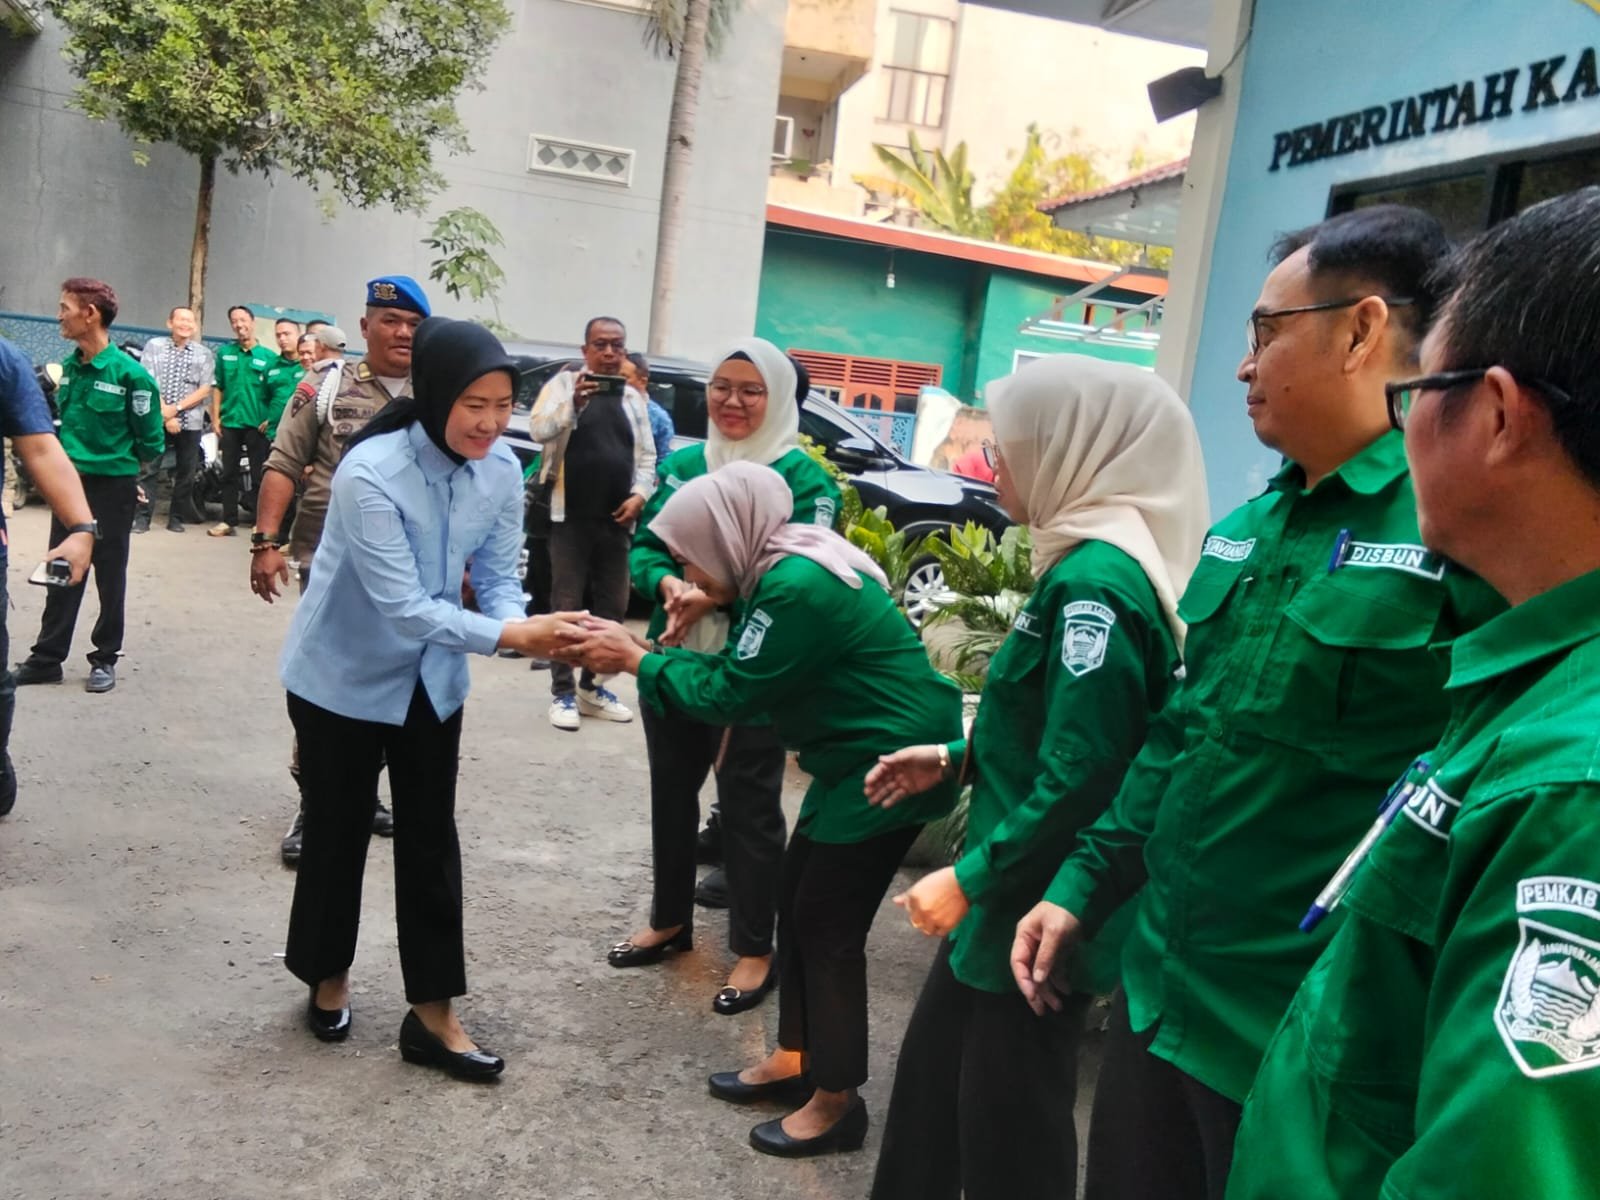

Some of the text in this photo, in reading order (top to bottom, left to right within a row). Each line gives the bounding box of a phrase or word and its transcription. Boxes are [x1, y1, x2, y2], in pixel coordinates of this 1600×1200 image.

[1268, 68, 1520, 173] PEMERINTAH
[1350, 546, 1424, 569] DISBUN
[1523, 882, 1598, 909] PEMKAB
